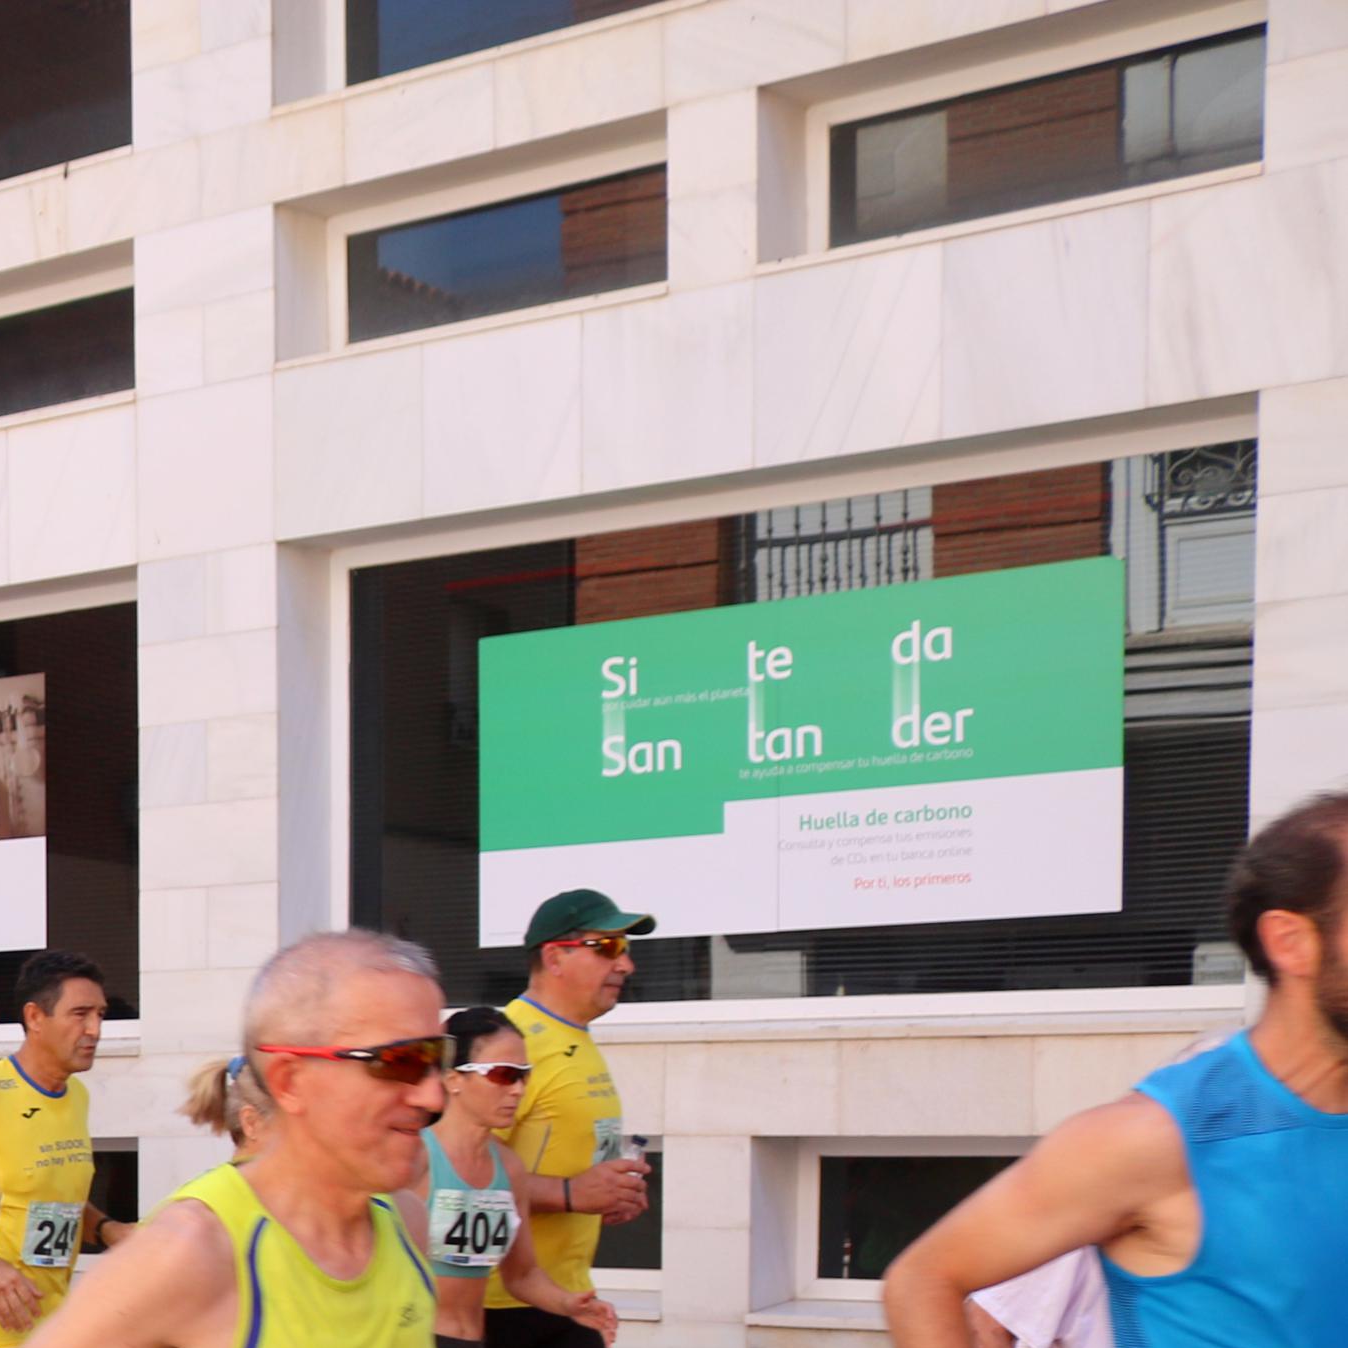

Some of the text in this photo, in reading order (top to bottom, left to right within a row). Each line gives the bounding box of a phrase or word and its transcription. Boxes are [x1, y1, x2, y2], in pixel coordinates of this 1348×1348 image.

[601, 619, 953, 699] Si te da
[601, 705, 975, 777] San tan der
[752, 763, 785, 780] ayuda
[795, 758, 856, 776] compensar
[857, 757, 871, 768] tu
[872, 752, 908, 766] huella
[910, 750, 923, 763] de
[925, 747, 974, 762] carbono
[799, 803, 974, 832] Huella de carbono
[835, 833, 893, 849] compensa
[831, 854, 845, 866] de
[870, 852, 885, 863] en
[886, 850, 898, 863] tu
[854, 876, 874, 891] Por
[893, 874, 912, 888] los
[914, 872, 972, 890] primeros
[443, 1211, 510, 1254] 404
